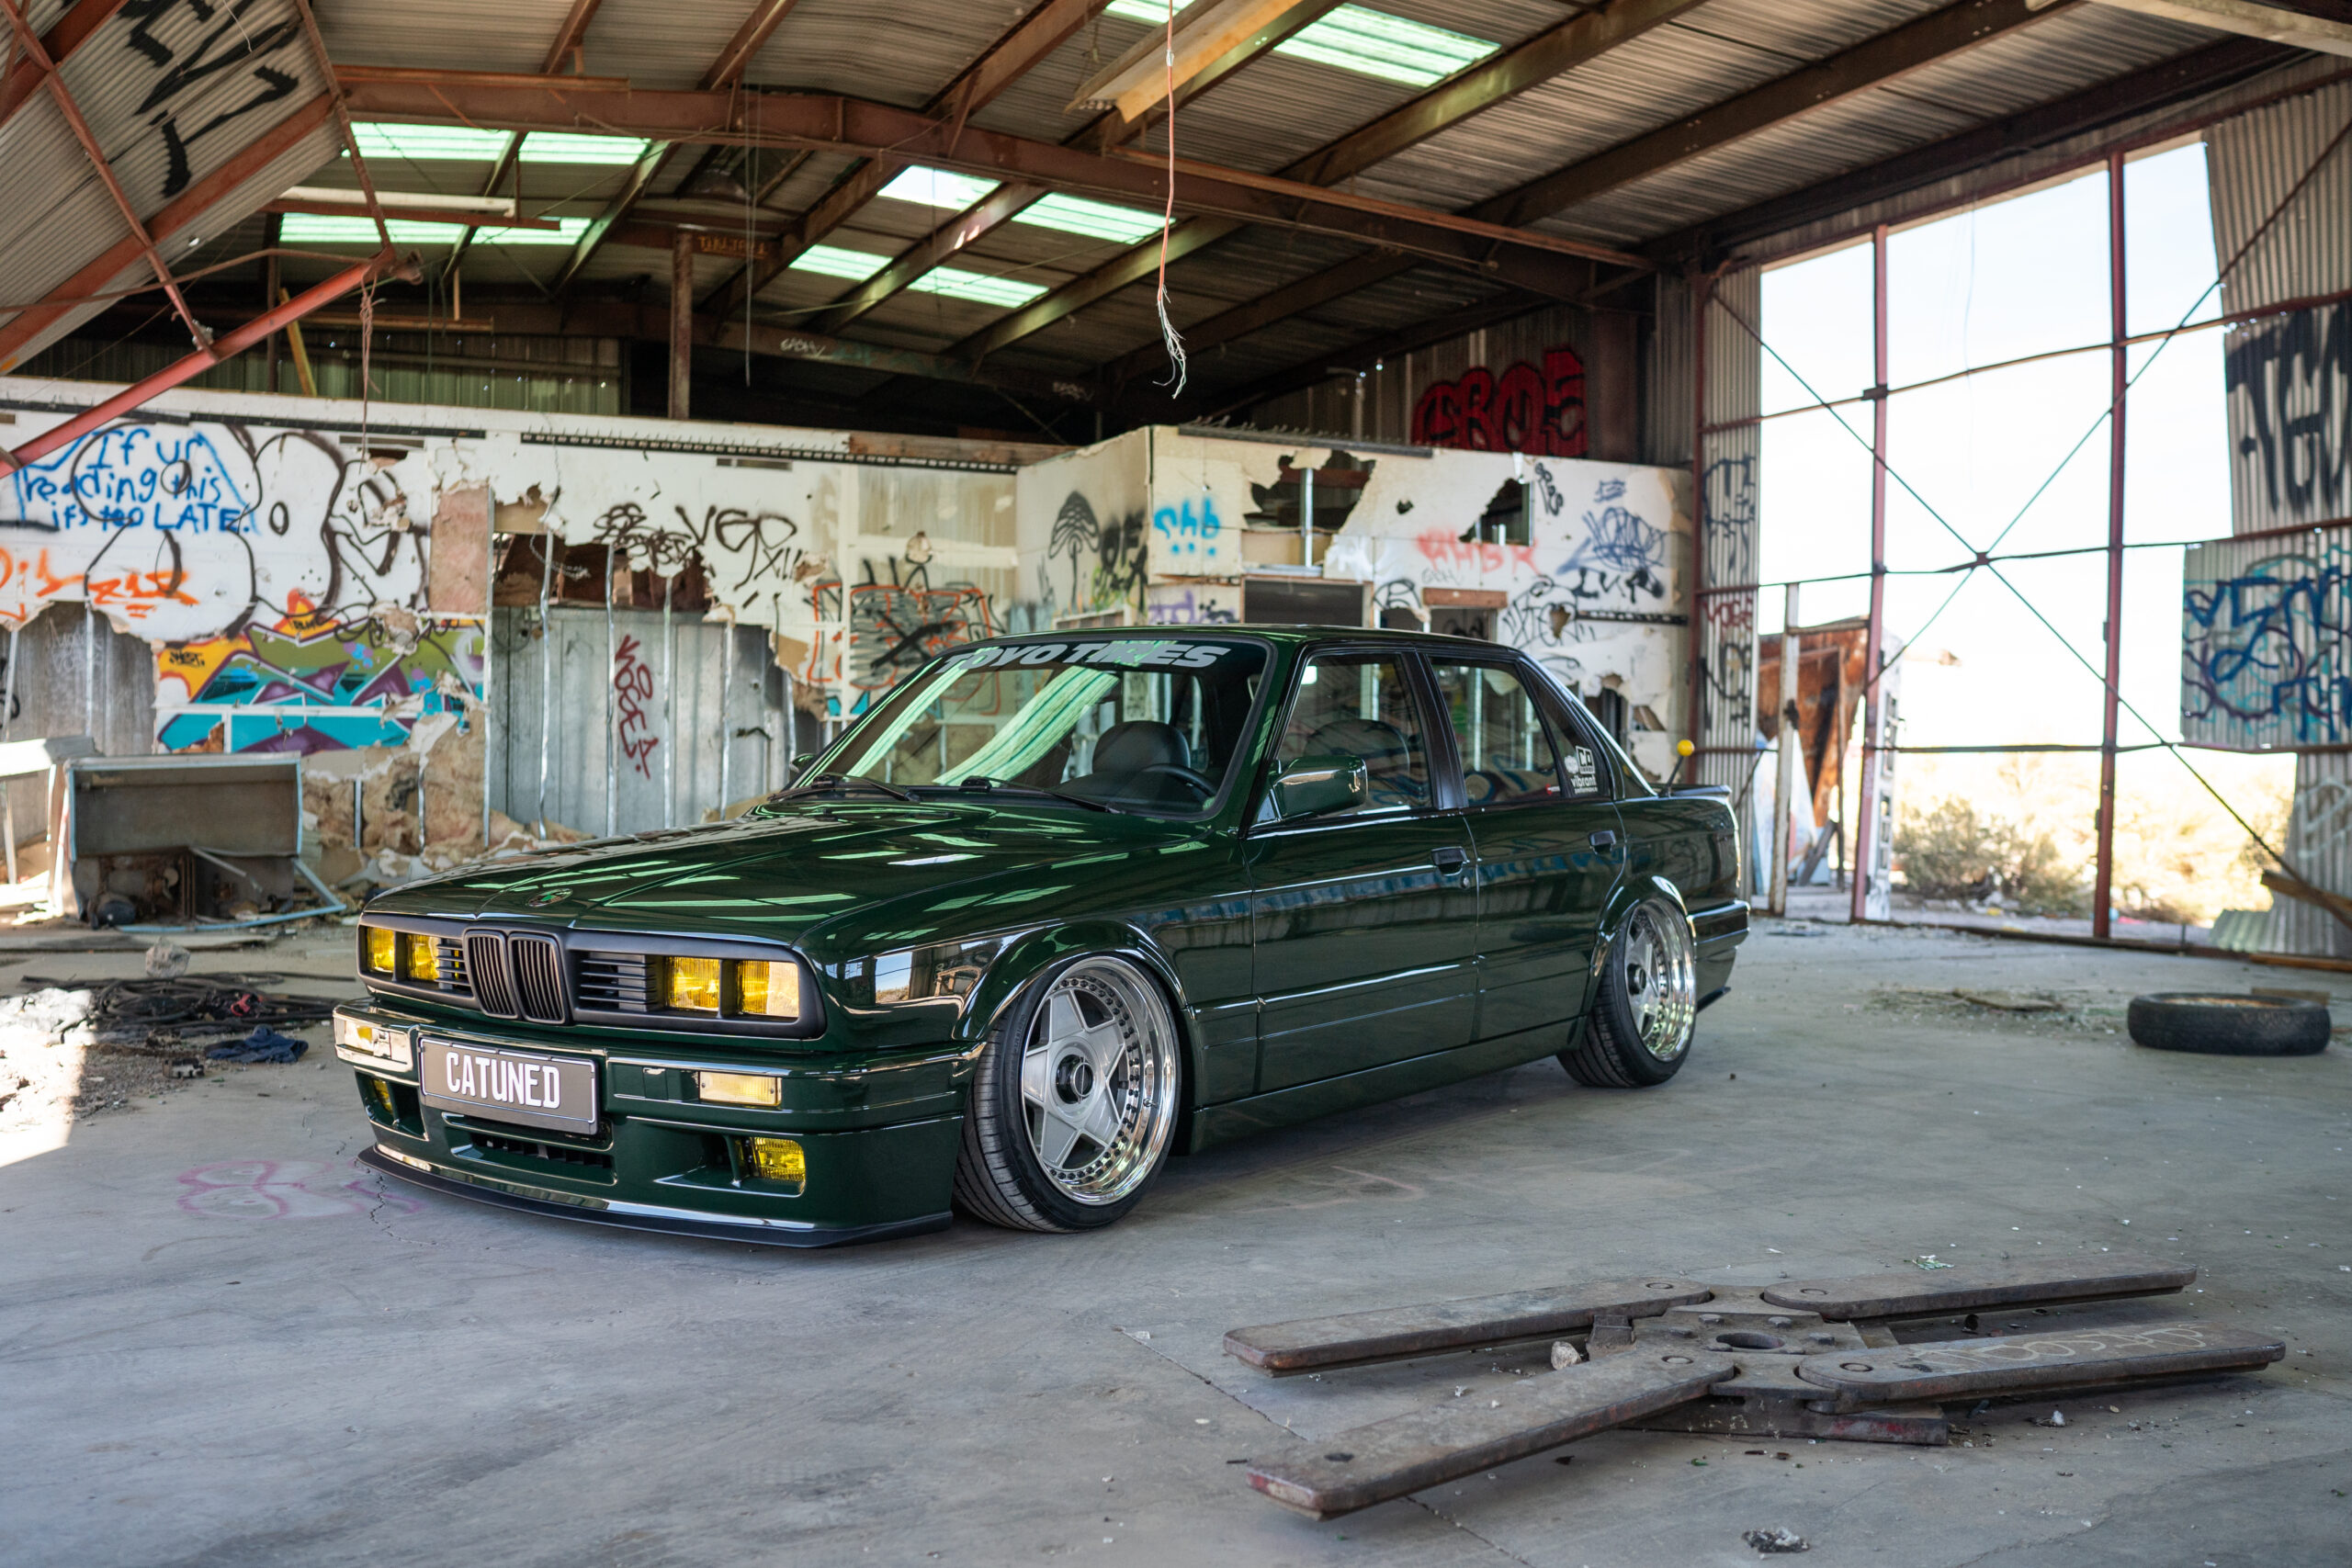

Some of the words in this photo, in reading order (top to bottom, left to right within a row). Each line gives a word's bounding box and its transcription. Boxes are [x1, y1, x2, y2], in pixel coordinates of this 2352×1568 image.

[86, 428, 150, 468] If
[156, 438, 203, 464] ur
[26, 467, 157, 503] reading
[171, 466, 221, 502] this
[934, 644, 1067, 674] TOYO
[1069, 641, 1232, 668] TIRES
[446, 1052, 560, 1109] CATUNED
